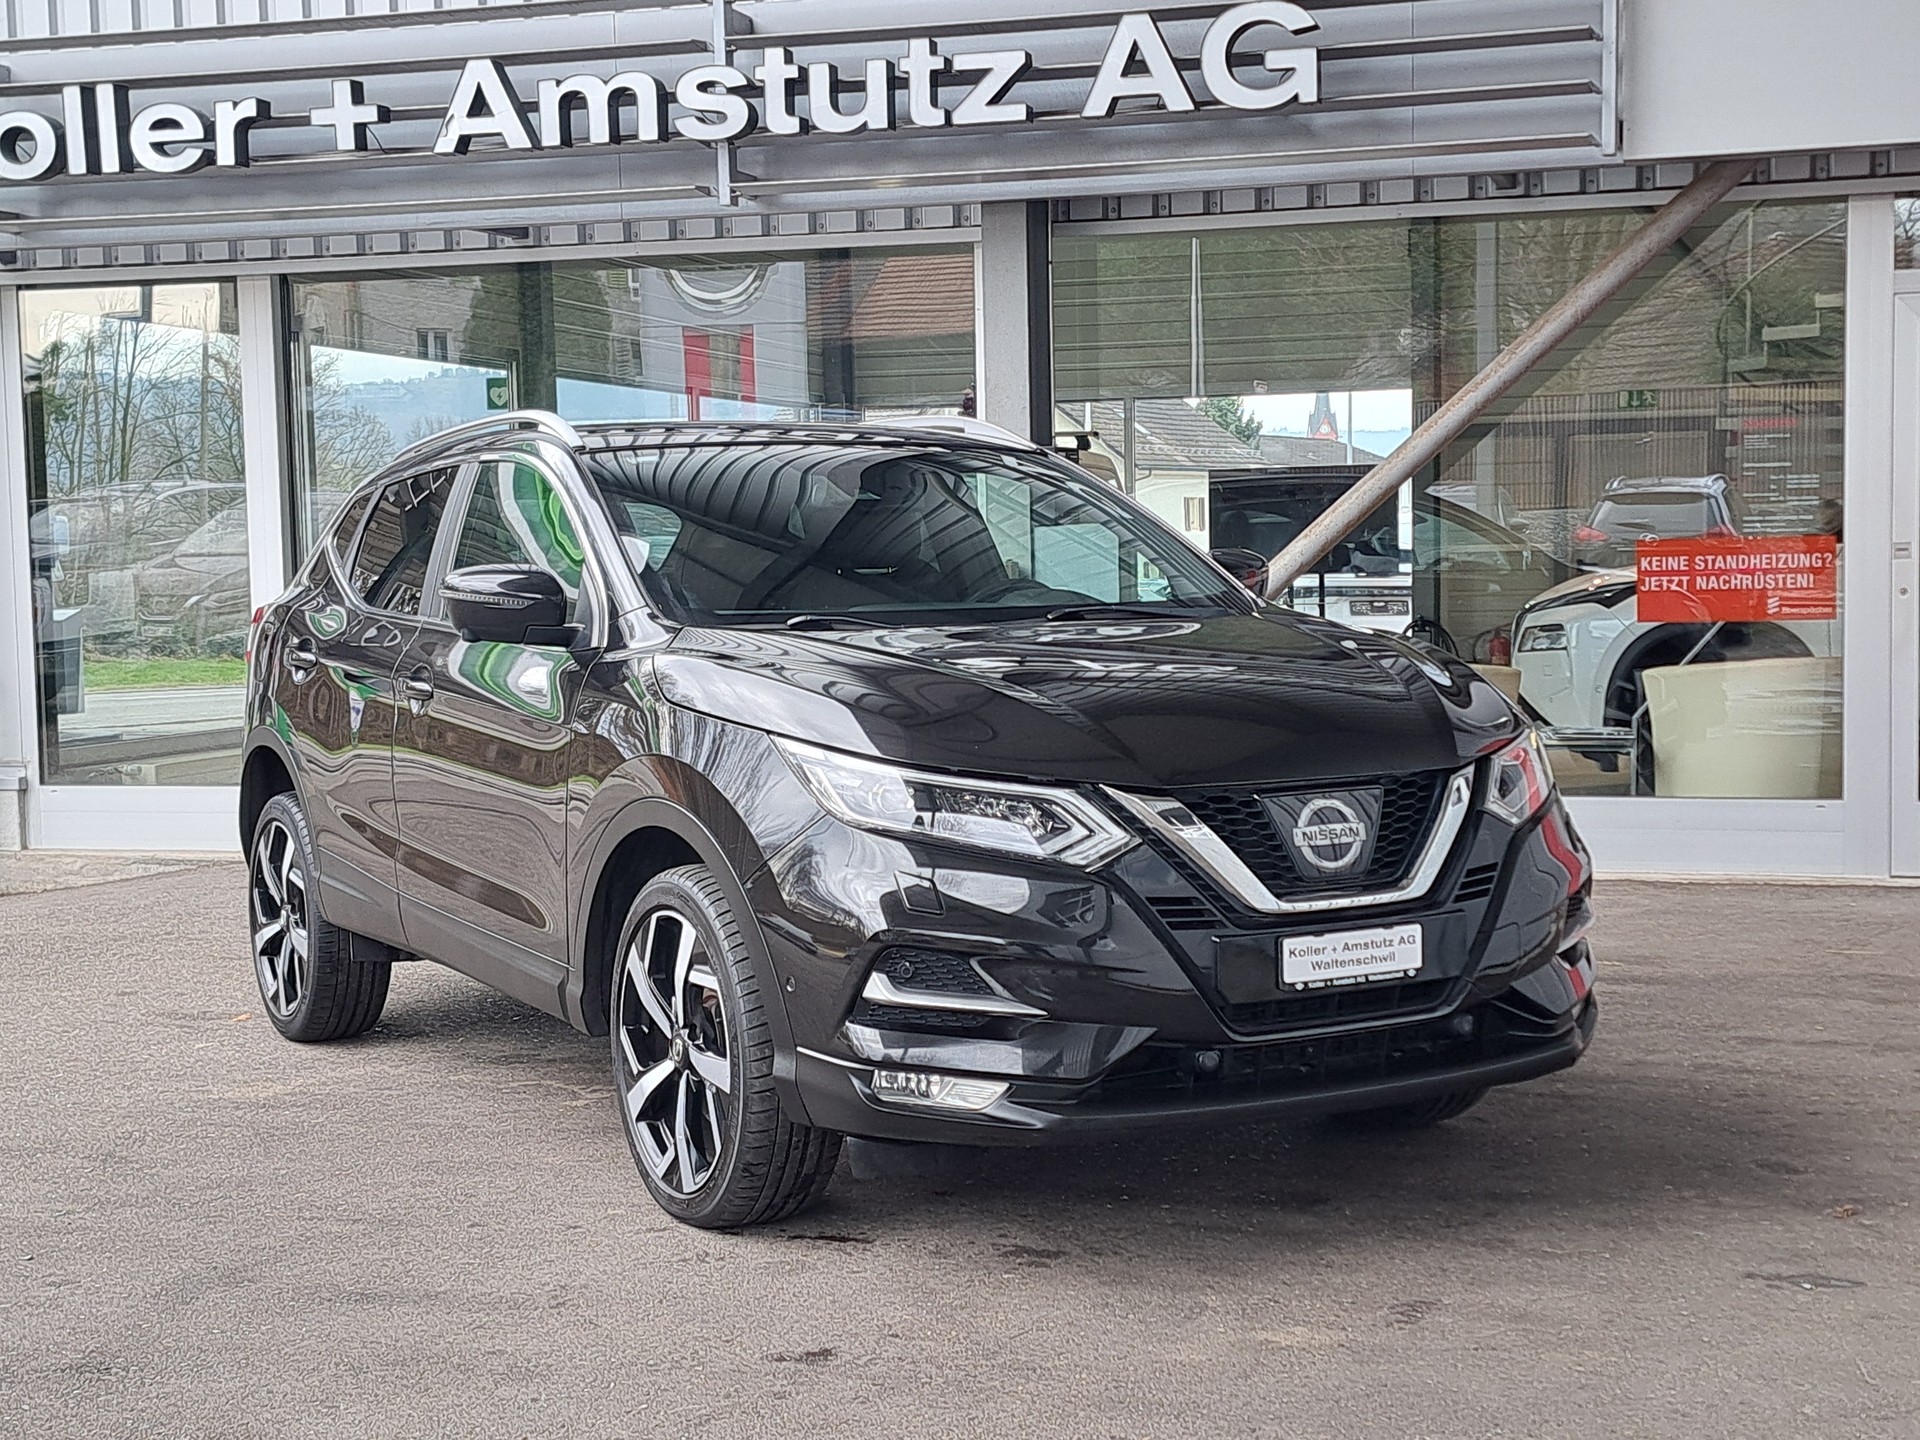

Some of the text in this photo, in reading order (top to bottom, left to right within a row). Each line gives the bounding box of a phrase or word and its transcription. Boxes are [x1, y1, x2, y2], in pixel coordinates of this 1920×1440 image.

[432, 38, 1031, 156] Amstutz
[1080, 0, 1321, 119] AG
[1640, 552, 1833, 571] KEINE STANDHEIZUNG?
[1640, 571, 1815, 592] JETZT NACHRÜSTEN!
[1302, 826, 1360, 842] NISSAN
[1288, 946, 1328, 959] Koller
[1341, 938, 1395, 953] Amstutz
[1397, 934, 1417, 945] AG
[1310, 951, 1396, 972] Waltenschwil
